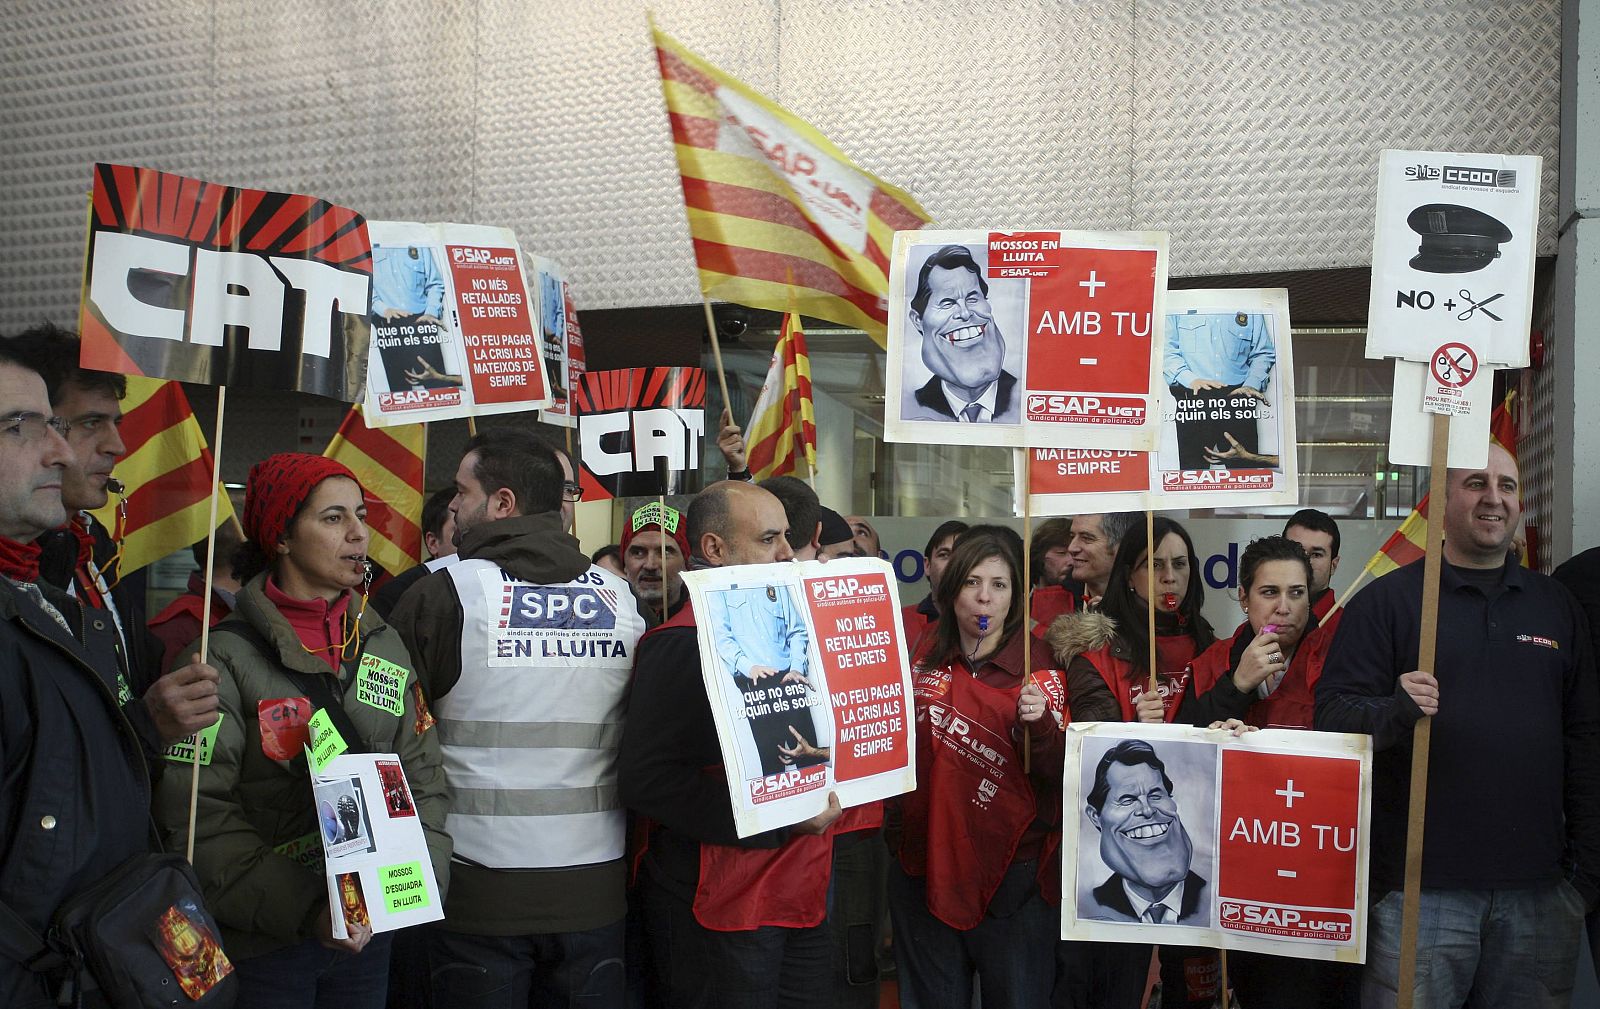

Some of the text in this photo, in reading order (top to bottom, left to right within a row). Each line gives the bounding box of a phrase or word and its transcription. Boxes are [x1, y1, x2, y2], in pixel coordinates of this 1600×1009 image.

[1446, 169, 1493, 183] CCOO
[990, 241, 1058, 250] MOSSOS EN
[1003, 253, 1044, 262] LLUITA
[472, 277, 508, 290] NO MÉS
[91, 231, 369, 358] CAT
[462, 293, 521, 304] RETALLADES
[1397, 290, 1434, 310] NO
[472, 306, 517, 318] DE DRETS
[377, 324, 437, 338] que no ens
[1036, 311, 1151, 337] AMB TU
[404, 335, 420, 346] els
[465, 334, 533, 346] NO FEU PAGAR
[473, 349, 488, 360] LA
[489, 348, 513, 359] CRISI
[514, 347, 532, 359] ALS
[473, 361, 535, 374] MATEIXOS DE
[490, 375, 527, 387] SEMPRE
[1178, 398, 1256, 411] que no ens
[1210, 408, 1231, 419] els
[580, 409, 704, 475] CAT
[1057, 461, 1120, 475] SEMPRE
[641, 508, 670, 516] MOSSS
[645, 517, 675, 531] LLUTA!
[500, 569, 604, 586] MOS
[520, 592, 598, 619] SPC
[836, 613, 875, 632] NO MÉS
[497, 640, 627, 657] EN LLUITA
[825, 631, 891, 652] RETALLADES
[838, 649, 887, 669] DE DRETS
[359, 690, 371, 702] EN
[744, 683, 805, 705] que no ens
[831, 683, 902, 707] NO FEU PAGAR
[773, 698, 790, 713] els
[842, 700, 900, 724] LA CRISI ALS
[840, 717, 902, 743] MATEIXOS DE
[316, 742, 337, 766] EN LLUITA
[853, 737, 893, 758] SEMPRE
[989, 768, 1003, 779] UGT
[983, 780, 998, 794] UGT
[1229, 817, 1355, 852] AMB TU
[388, 866, 413, 879] MOSSOS
[385, 879, 423, 894] D'ESQUADRA
[393, 895, 422, 908] EN LLUITA
[1223, 921, 1253, 931] sindicat
[1255, 926, 1289, 936] autònom
